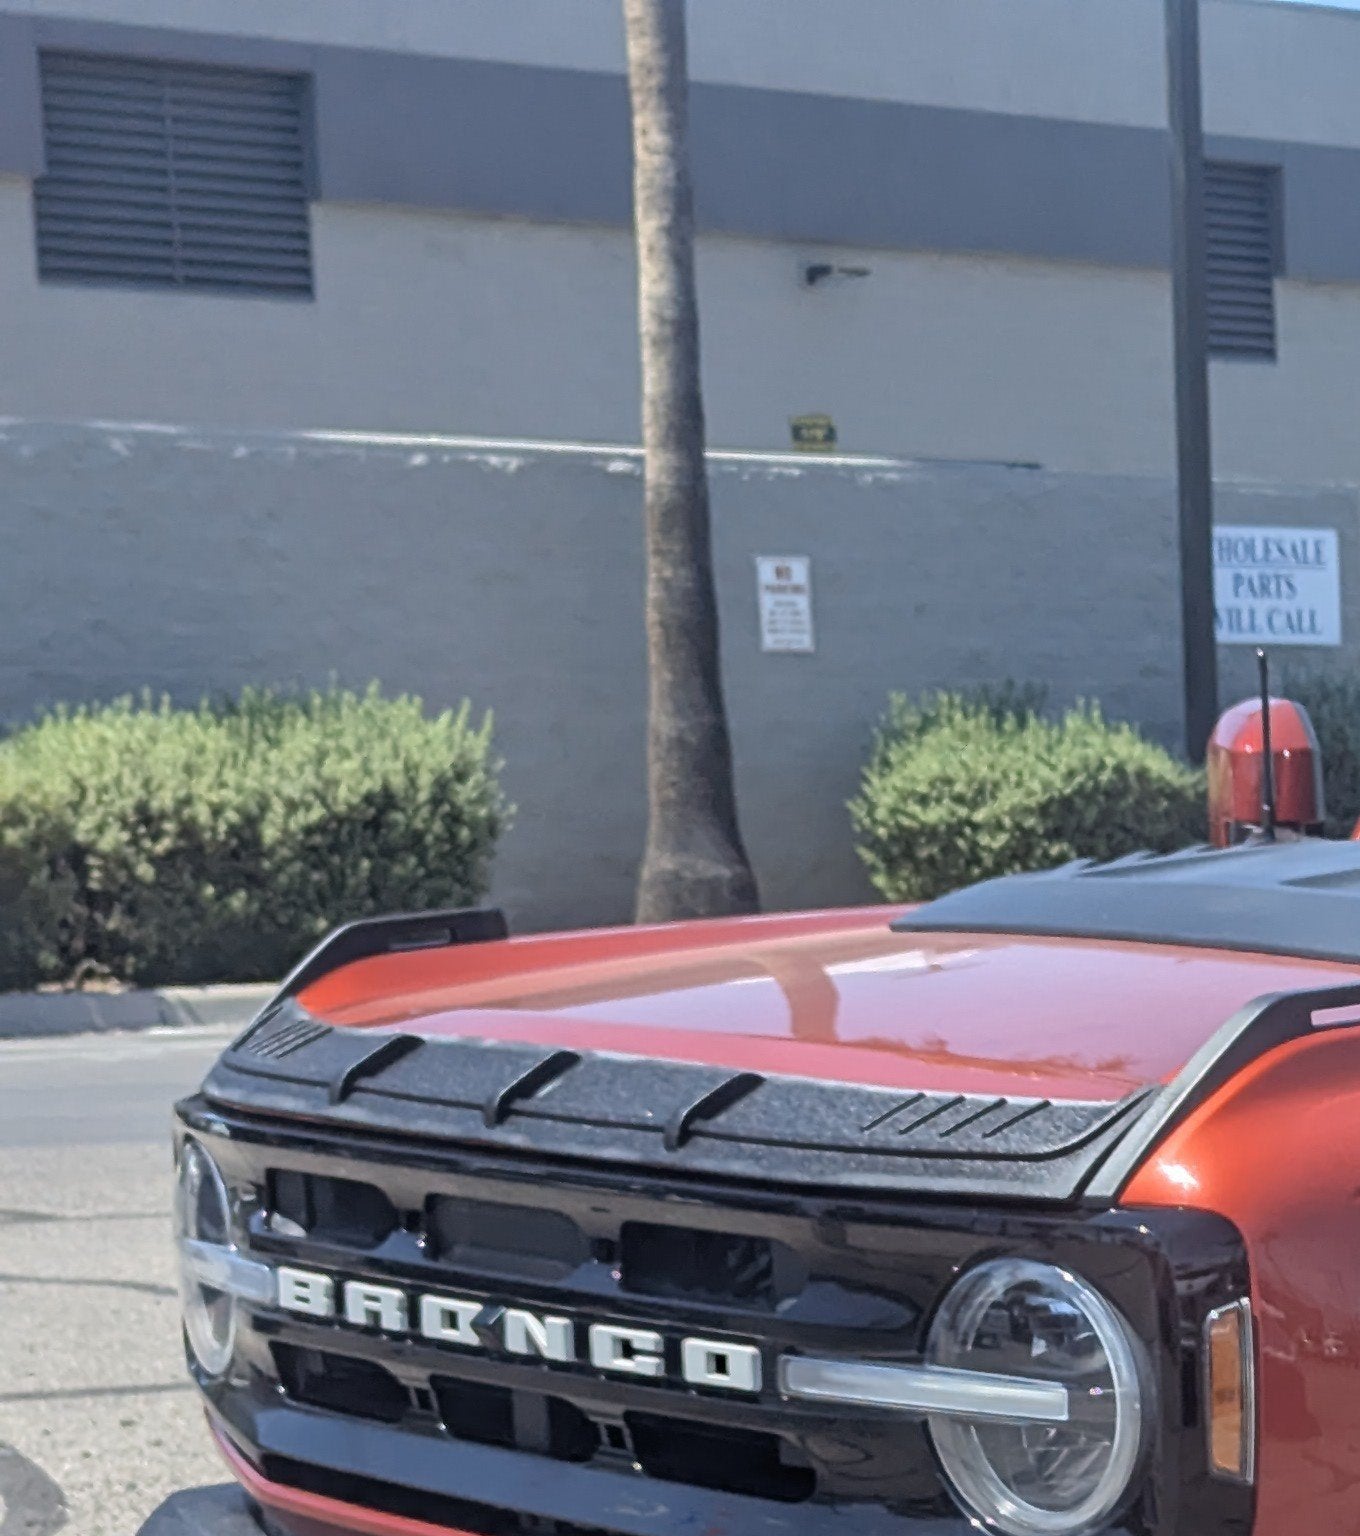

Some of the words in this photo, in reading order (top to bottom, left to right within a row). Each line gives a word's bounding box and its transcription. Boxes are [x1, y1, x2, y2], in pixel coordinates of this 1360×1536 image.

[1212, 536, 1327, 565] HOLESALE
[1233, 572, 1298, 599] PARTS
[1266, 608, 1322, 636] CALL
[278, 1266, 763, 1391] BRONCO
